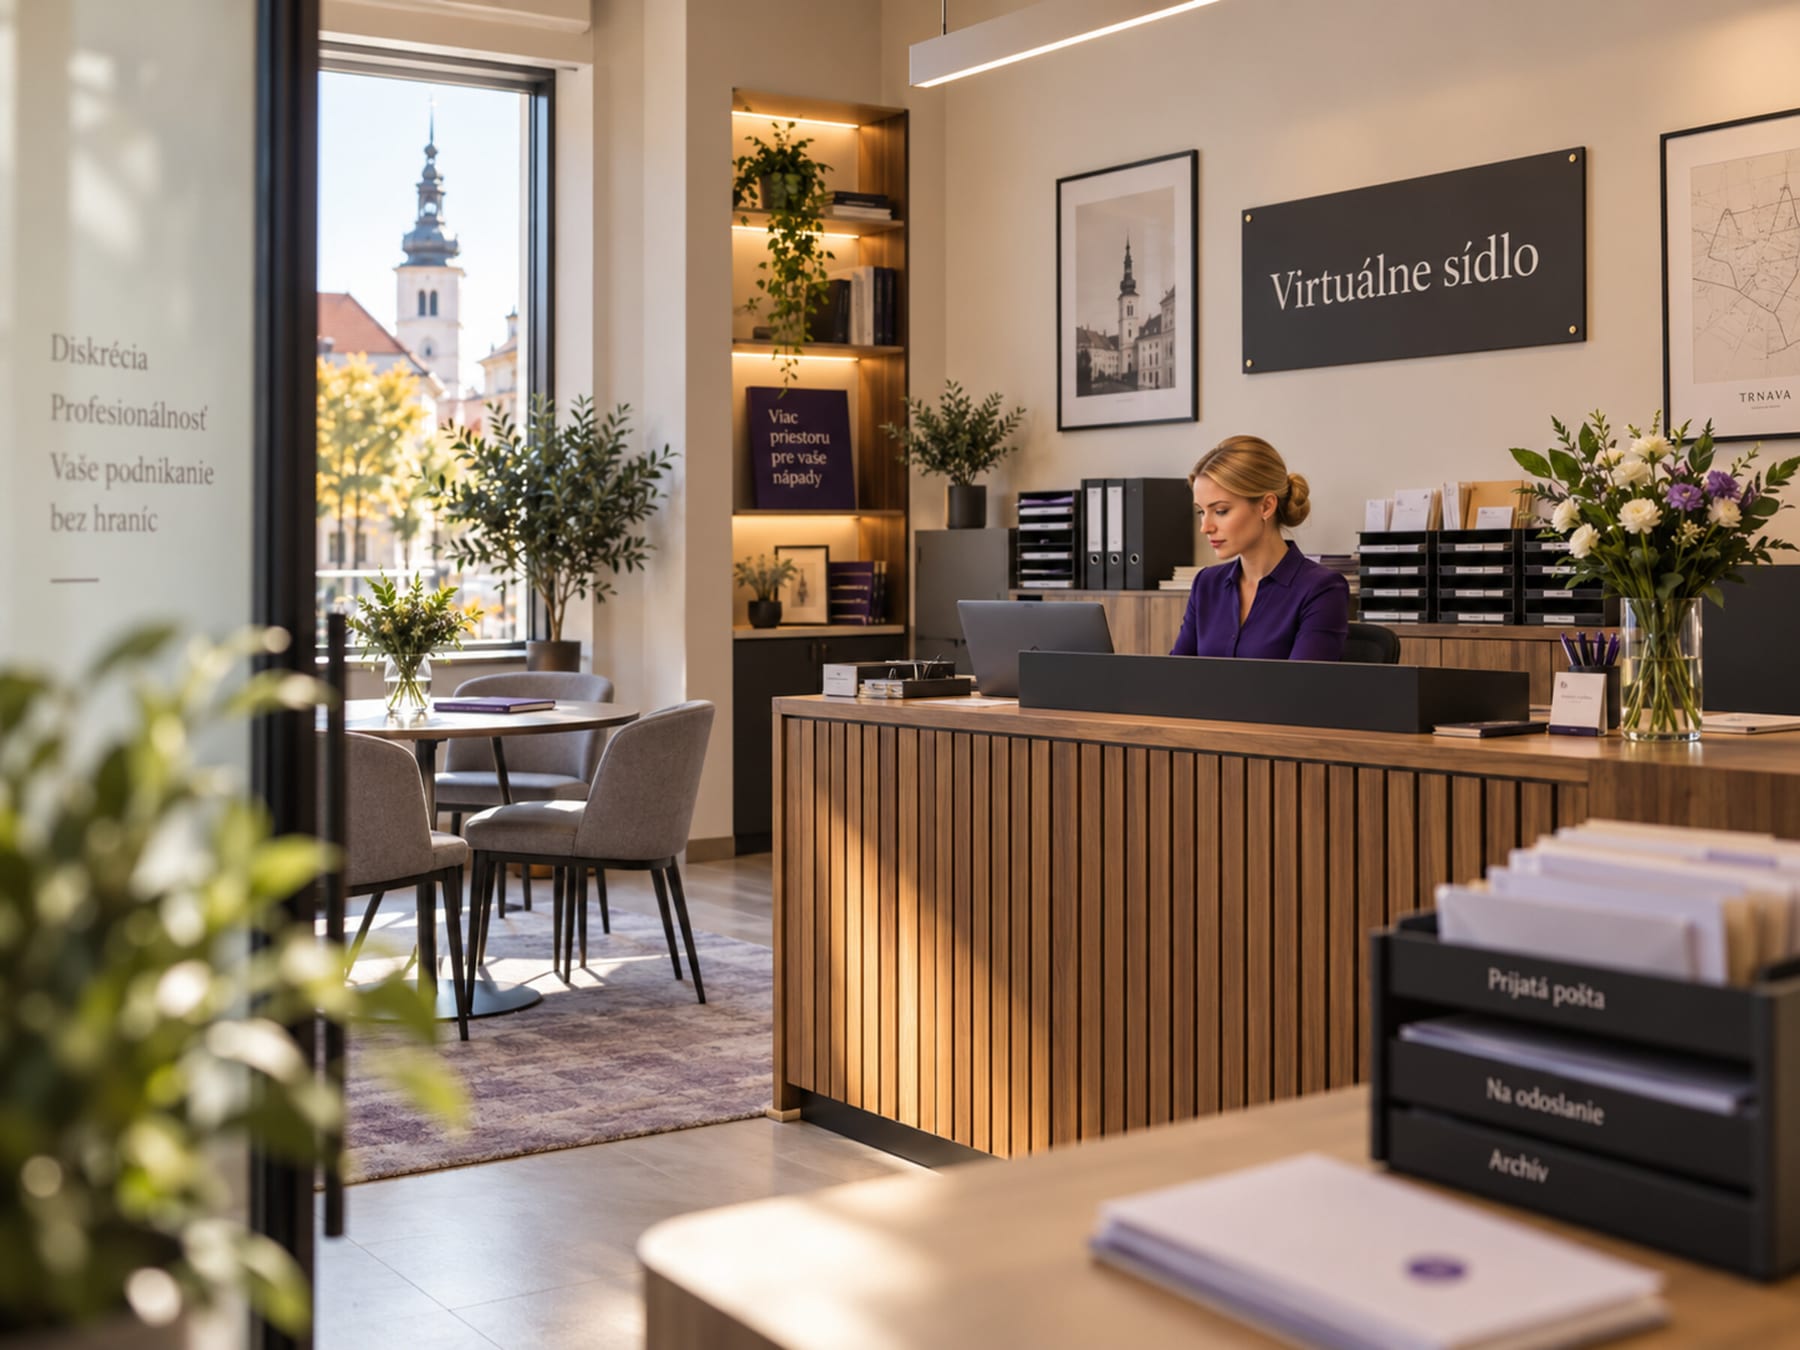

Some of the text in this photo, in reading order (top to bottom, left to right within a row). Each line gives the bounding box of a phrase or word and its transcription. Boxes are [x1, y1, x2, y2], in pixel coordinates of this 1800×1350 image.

[1270, 232, 1539, 310] Virtuálne sídlo
[51, 333, 148, 370] Diskrécia
[51, 393, 208, 431] Profesionálnosť
[1739, 390, 1791, 402] TRNAVA
[768, 409, 799, 424] Viac
[770, 429, 830, 447] priestoru
[50, 452, 214, 490] Vaše podnikanie
[771, 450, 827, 467] pre vaše
[773, 469, 822, 488] nápady
[51, 503, 158, 532] bez hraníc
[1488, 967, 1605, 1010] Prijatá pošta
[1487, 1077, 1604, 1126] Na odoslanie
[1489, 1149, 1549, 1183] Archív
